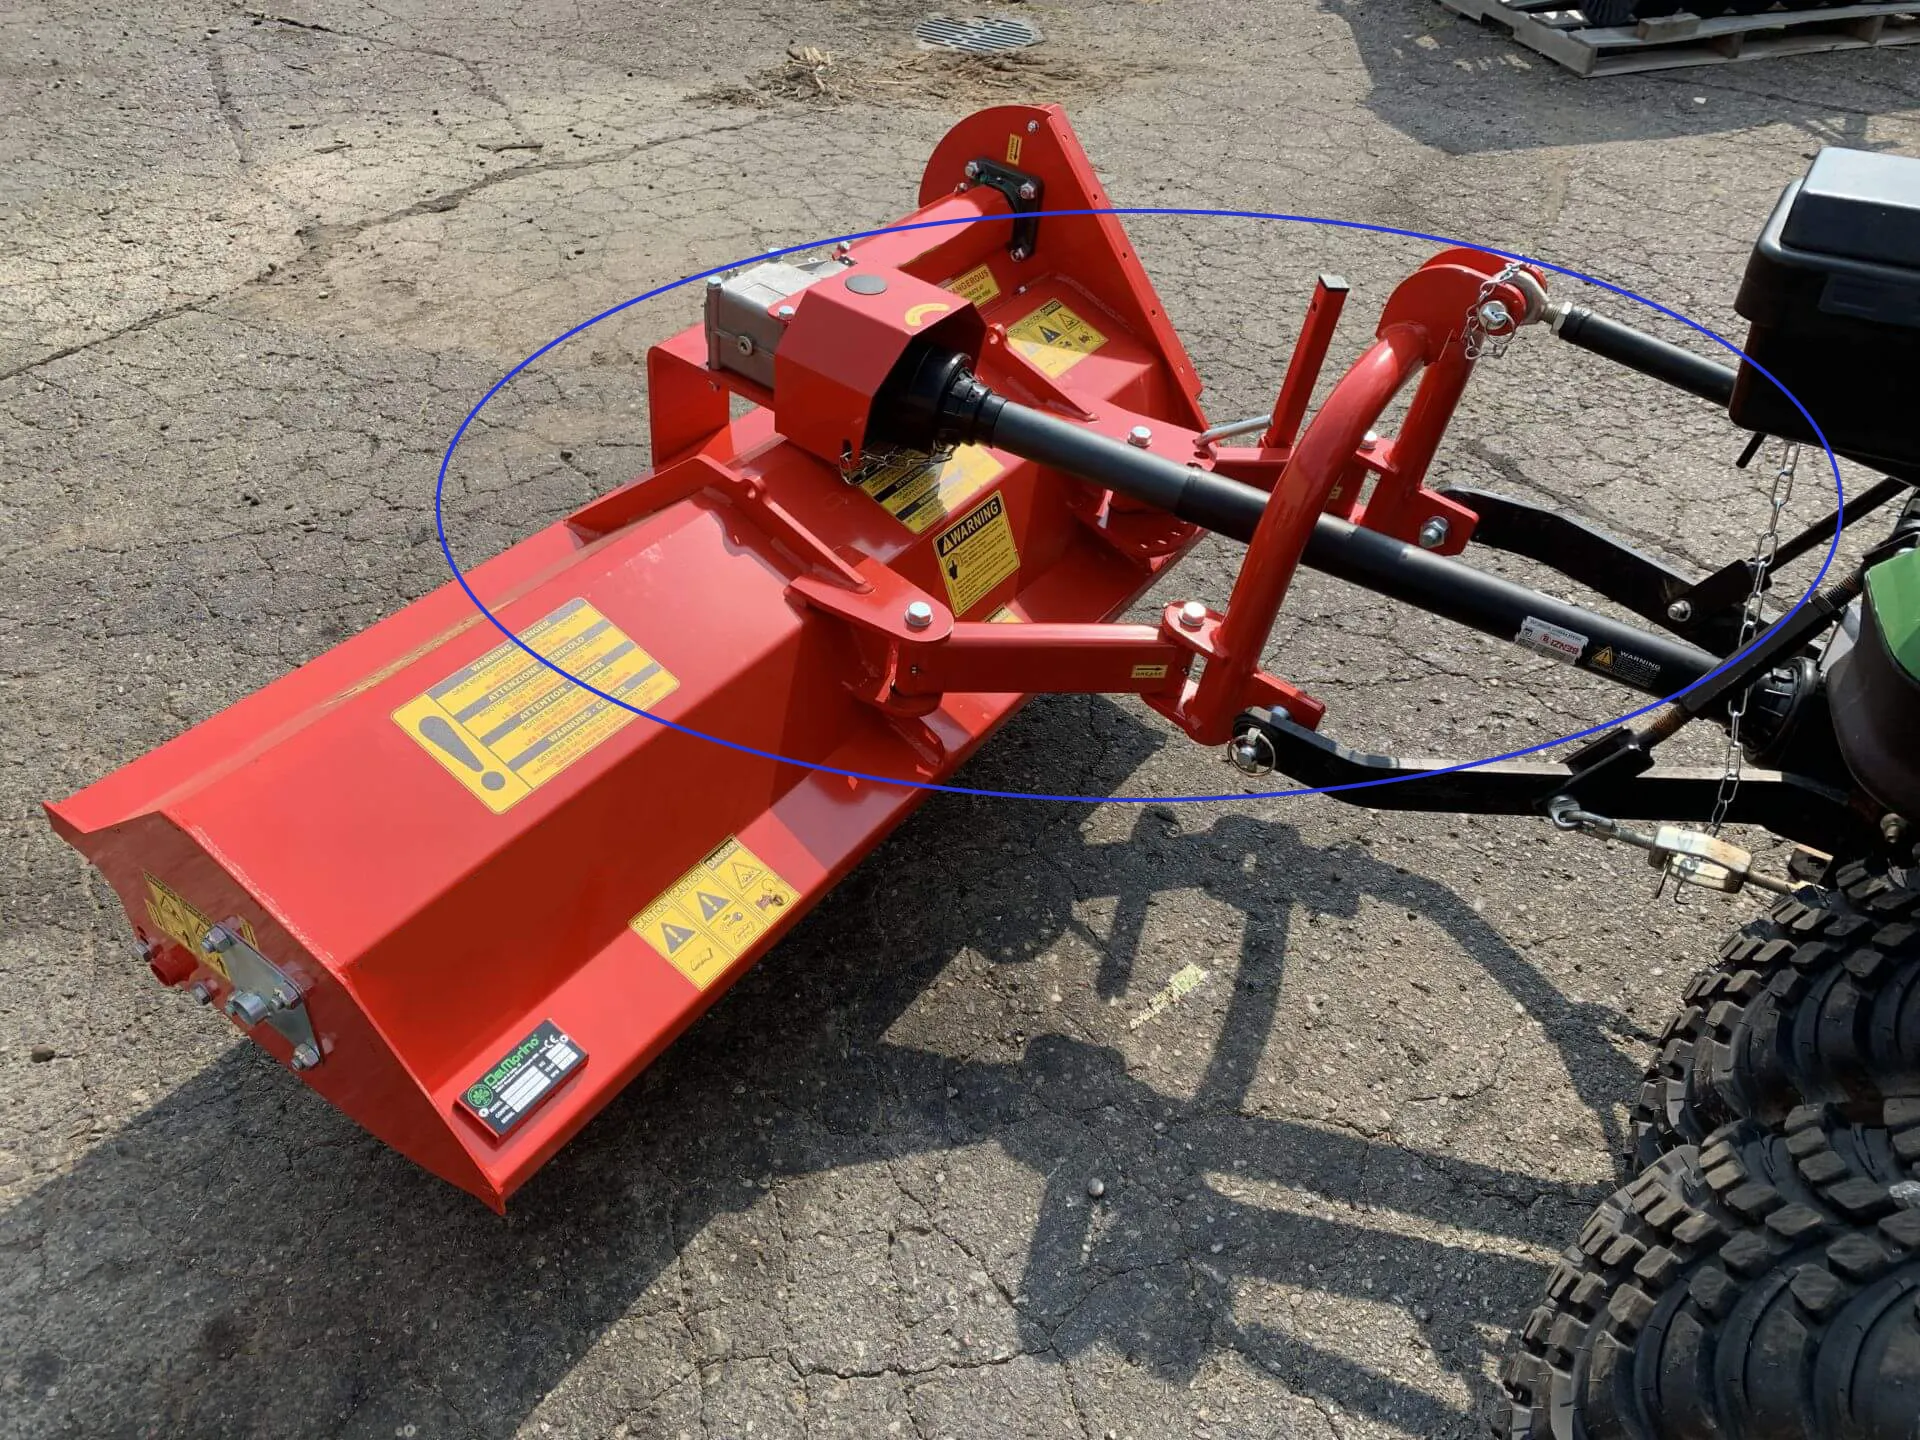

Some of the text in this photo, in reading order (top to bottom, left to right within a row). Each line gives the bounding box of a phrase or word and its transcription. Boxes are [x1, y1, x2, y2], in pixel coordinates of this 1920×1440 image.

[950, 501, 1000, 547] WARNING
[471, 643, 513, 672] WARNING
[1619, 650, 1662, 672] WARNING
[488, 664, 541, 702] ATTENZIONE
[519, 686, 567, 721] ATTENTION
[547, 710, 592, 743] WARNUNG
[707, 840, 738, 869] DANGER
[670, 867, 704, 898] CAUTION
[635, 899, 669, 930] CAUTION
